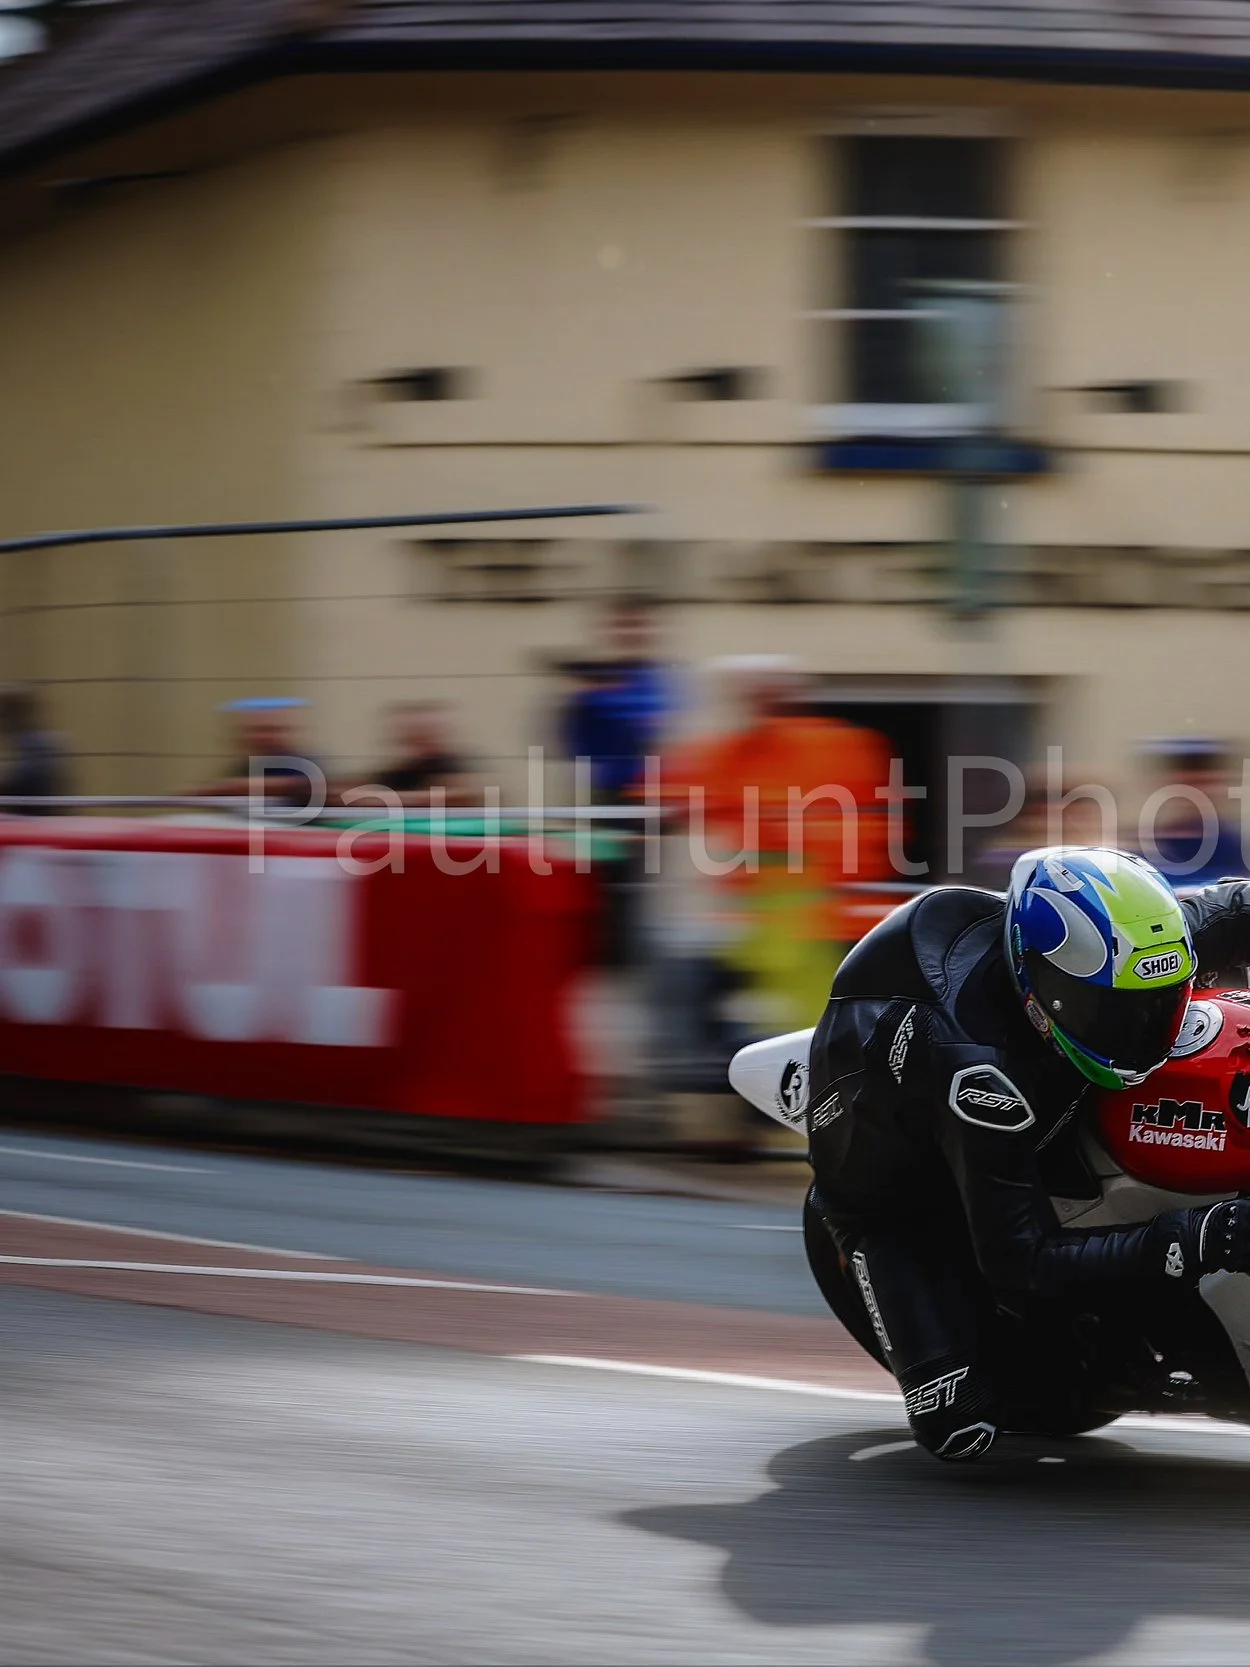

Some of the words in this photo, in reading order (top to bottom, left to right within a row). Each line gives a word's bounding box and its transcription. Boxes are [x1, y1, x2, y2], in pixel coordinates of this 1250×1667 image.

[1141, 954, 1179, 976] SHOEI
[957, 1087, 1026, 1111] RST
[1131, 1098, 1227, 1132] KMR
[1128, 1125, 1226, 1151] Kawasaki
